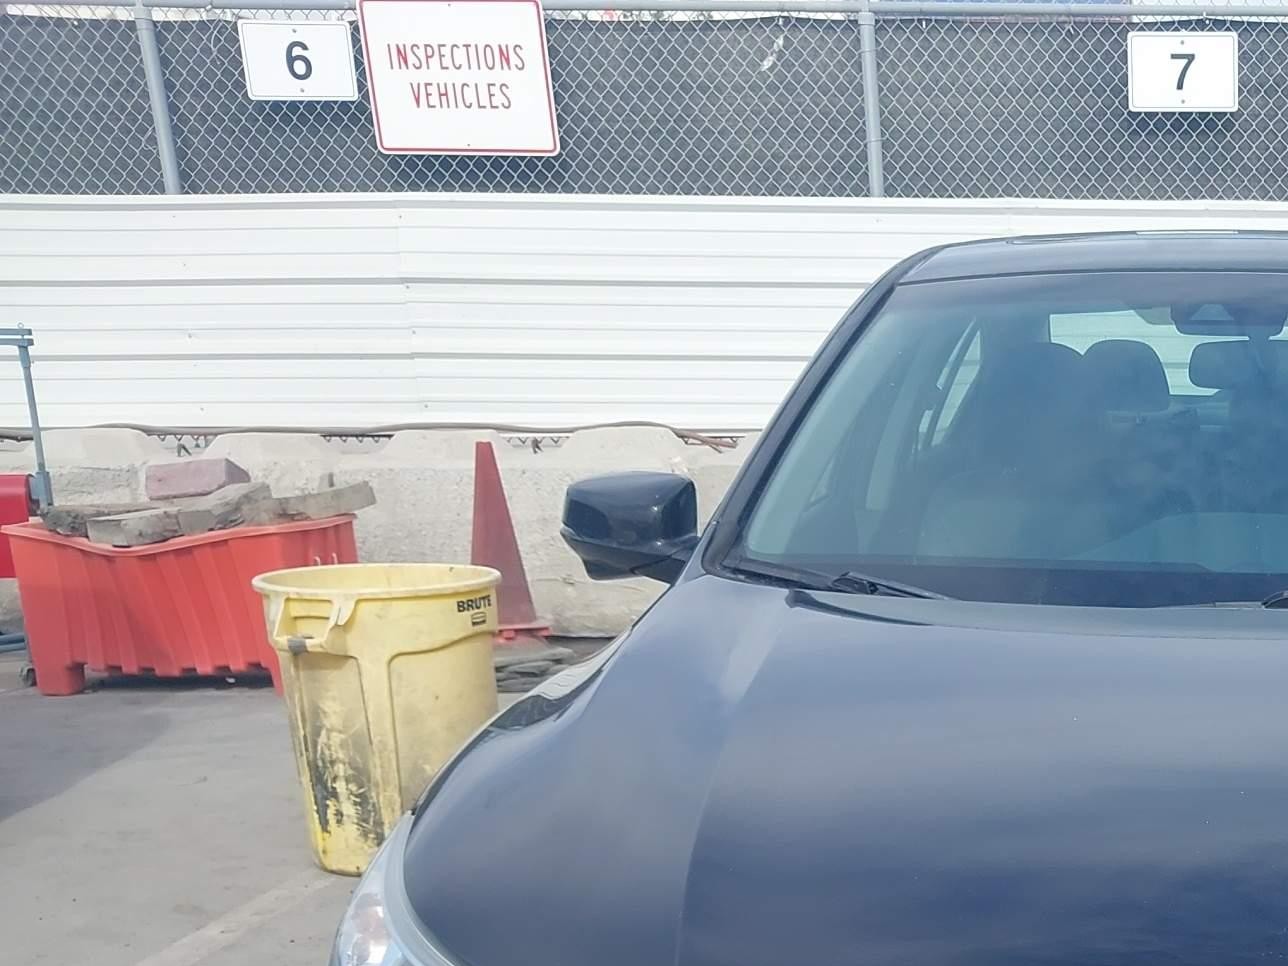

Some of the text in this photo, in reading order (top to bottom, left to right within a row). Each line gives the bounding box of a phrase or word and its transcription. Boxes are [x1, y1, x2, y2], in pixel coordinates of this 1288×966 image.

[286, 41, 312, 80] 6
[386, 43, 526, 71] INSPECTIONS
[1170, 53, 1196, 91] 7
[409, 82, 512, 110] VEHICLES
[456, 594, 492, 612] BRUTE
